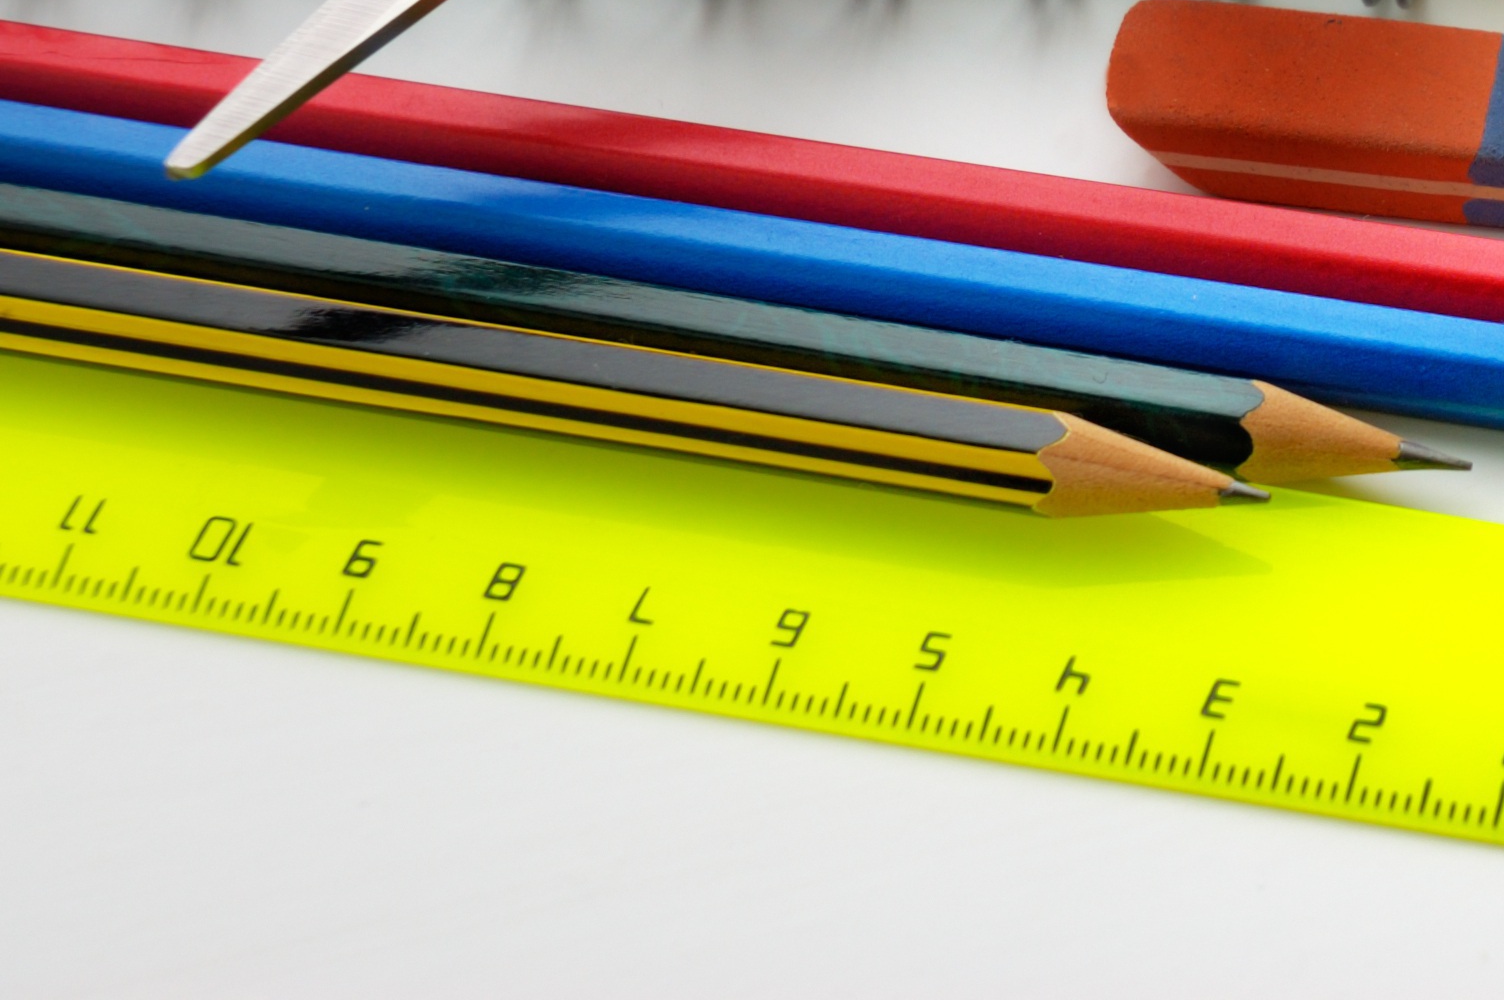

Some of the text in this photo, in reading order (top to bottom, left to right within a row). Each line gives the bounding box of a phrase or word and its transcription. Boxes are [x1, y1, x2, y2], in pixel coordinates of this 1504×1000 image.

[58, 494, 107, 535] 11
[188, 515, 254, 567] 10
[483, 561, 527, 601] 8
[627, 586, 654, 626] 7
[914, 631, 953, 672] 5
[1054, 655, 1091, 695] 4
[1201, 678, 1241, 720] 3
[1346, 702, 1387, 744] 2
